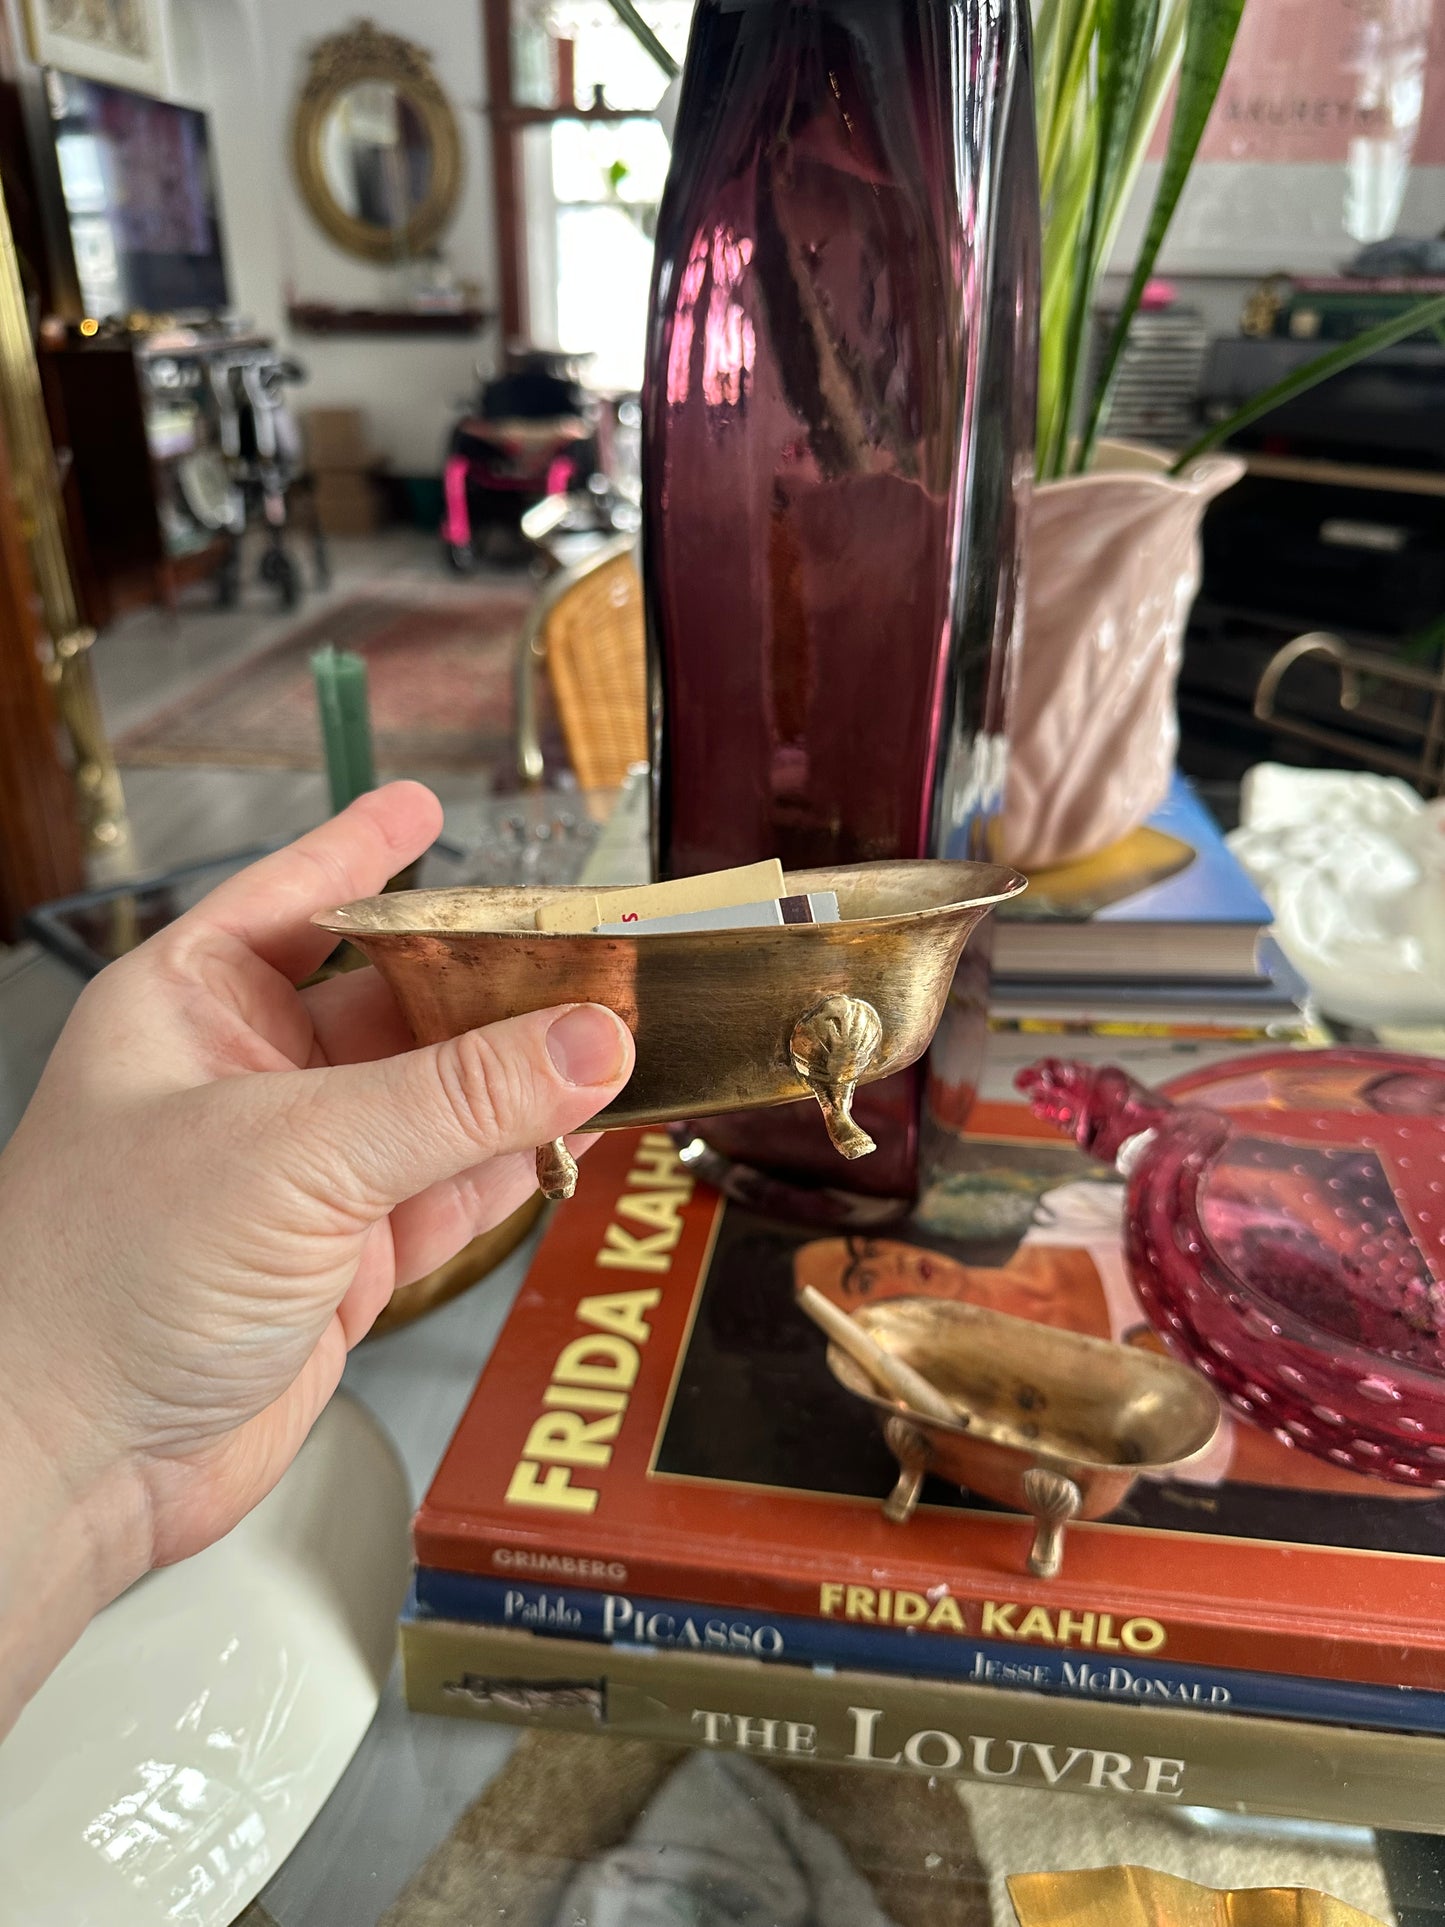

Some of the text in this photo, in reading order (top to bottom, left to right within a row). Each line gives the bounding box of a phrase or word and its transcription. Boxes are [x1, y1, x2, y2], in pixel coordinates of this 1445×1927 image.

[505, 1287, 663, 1513] FRIDA
[493, 1548, 627, 1582] GRIMBERG
[504, 1590, 784, 1656] Pablo PICASSO
[818, 1582, 1167, 1652] FRIDA KAHLO
[969, 1651, 1051, 1683] JESSE
[691, 1706, 1186, 1797] THE LOUVRE
